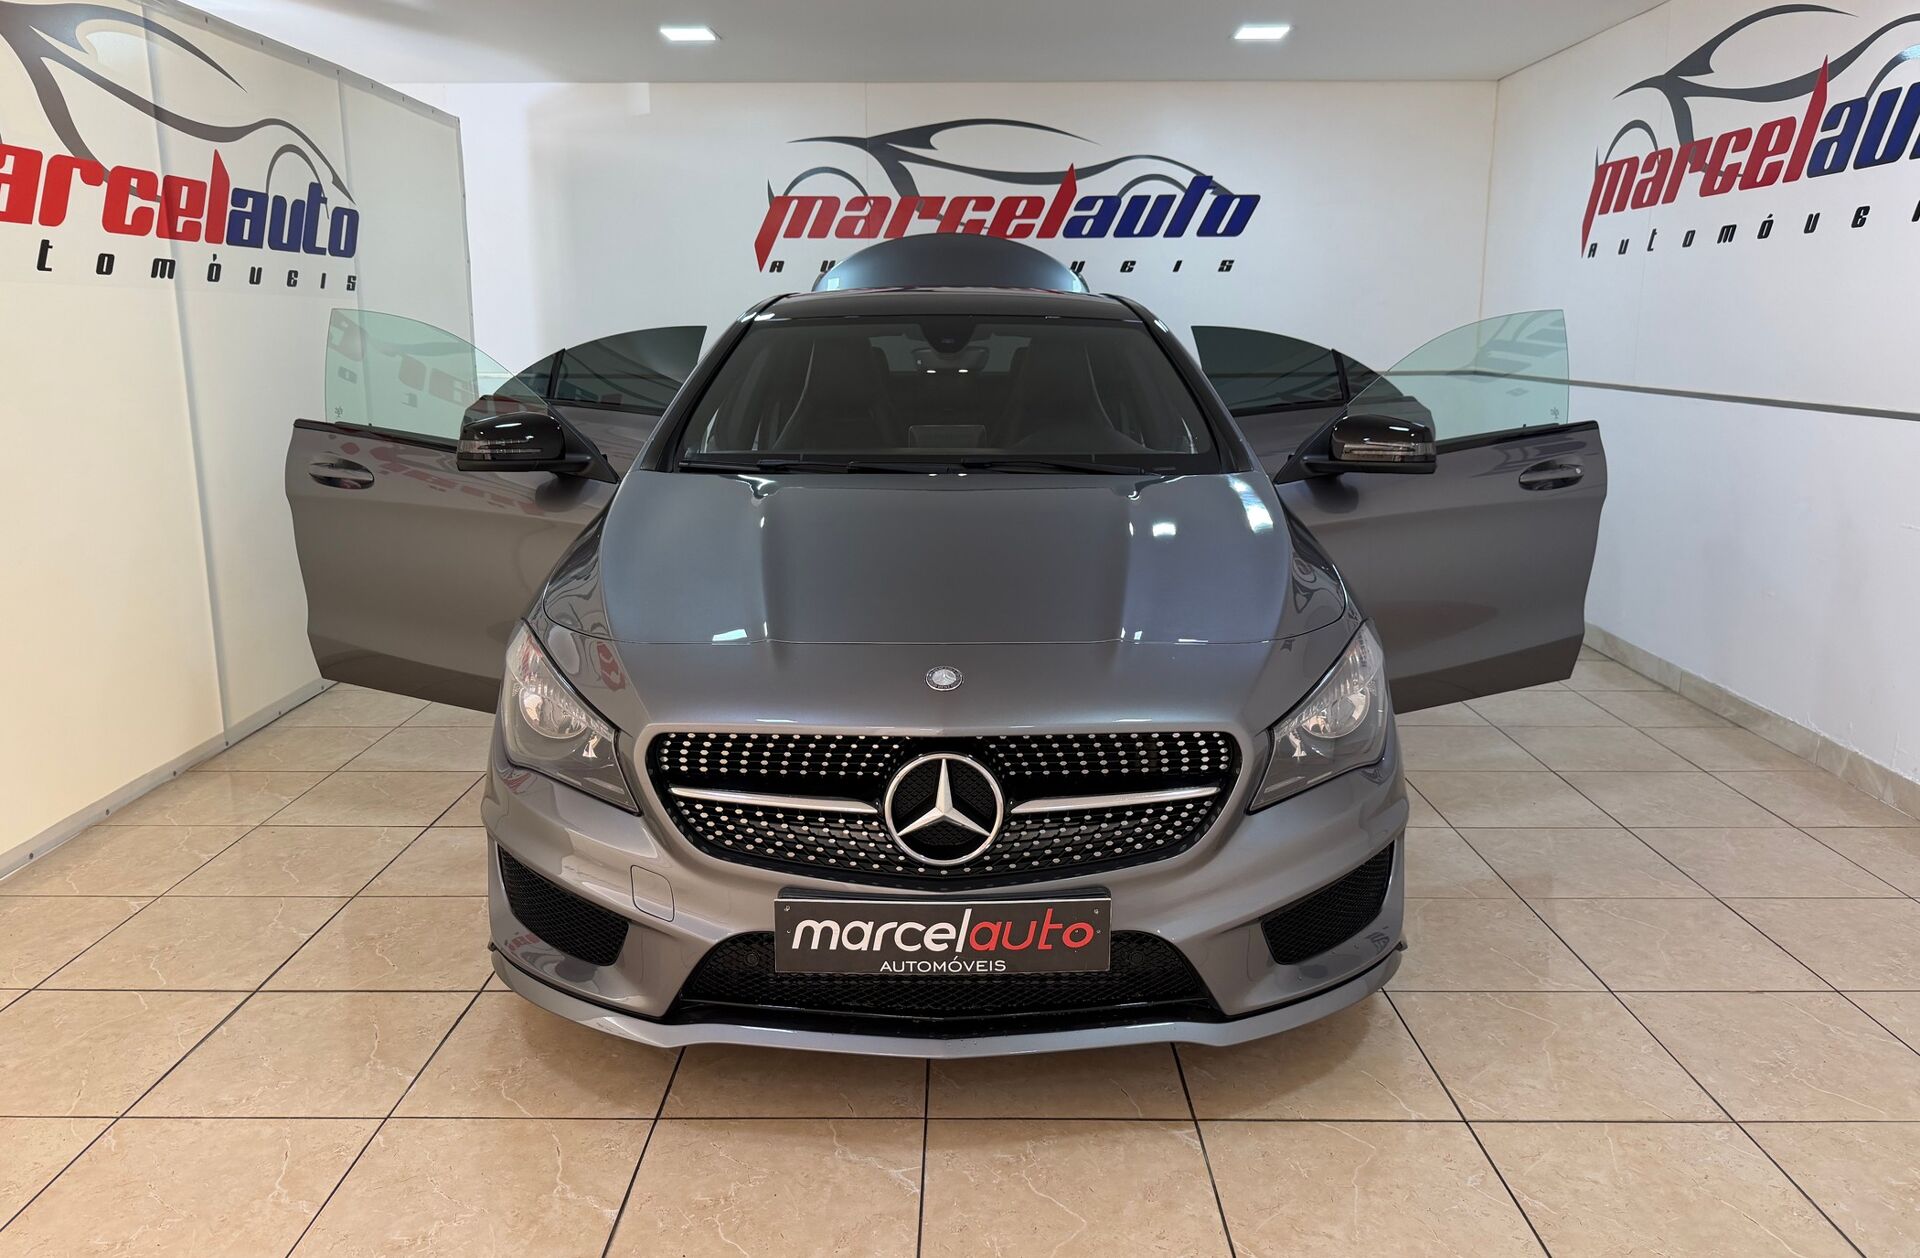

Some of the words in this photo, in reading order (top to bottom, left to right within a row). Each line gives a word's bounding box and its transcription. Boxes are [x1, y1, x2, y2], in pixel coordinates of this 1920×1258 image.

[0, 143, 360, 259] arcelauto
[1581, 54, 1920, 259] marcelau
[754, 162, 1261, 273] marcelauto
[791, 908, 1095, 953] marcelauto
[880, 956, 1007, 973] AUTOMÓVEIS
